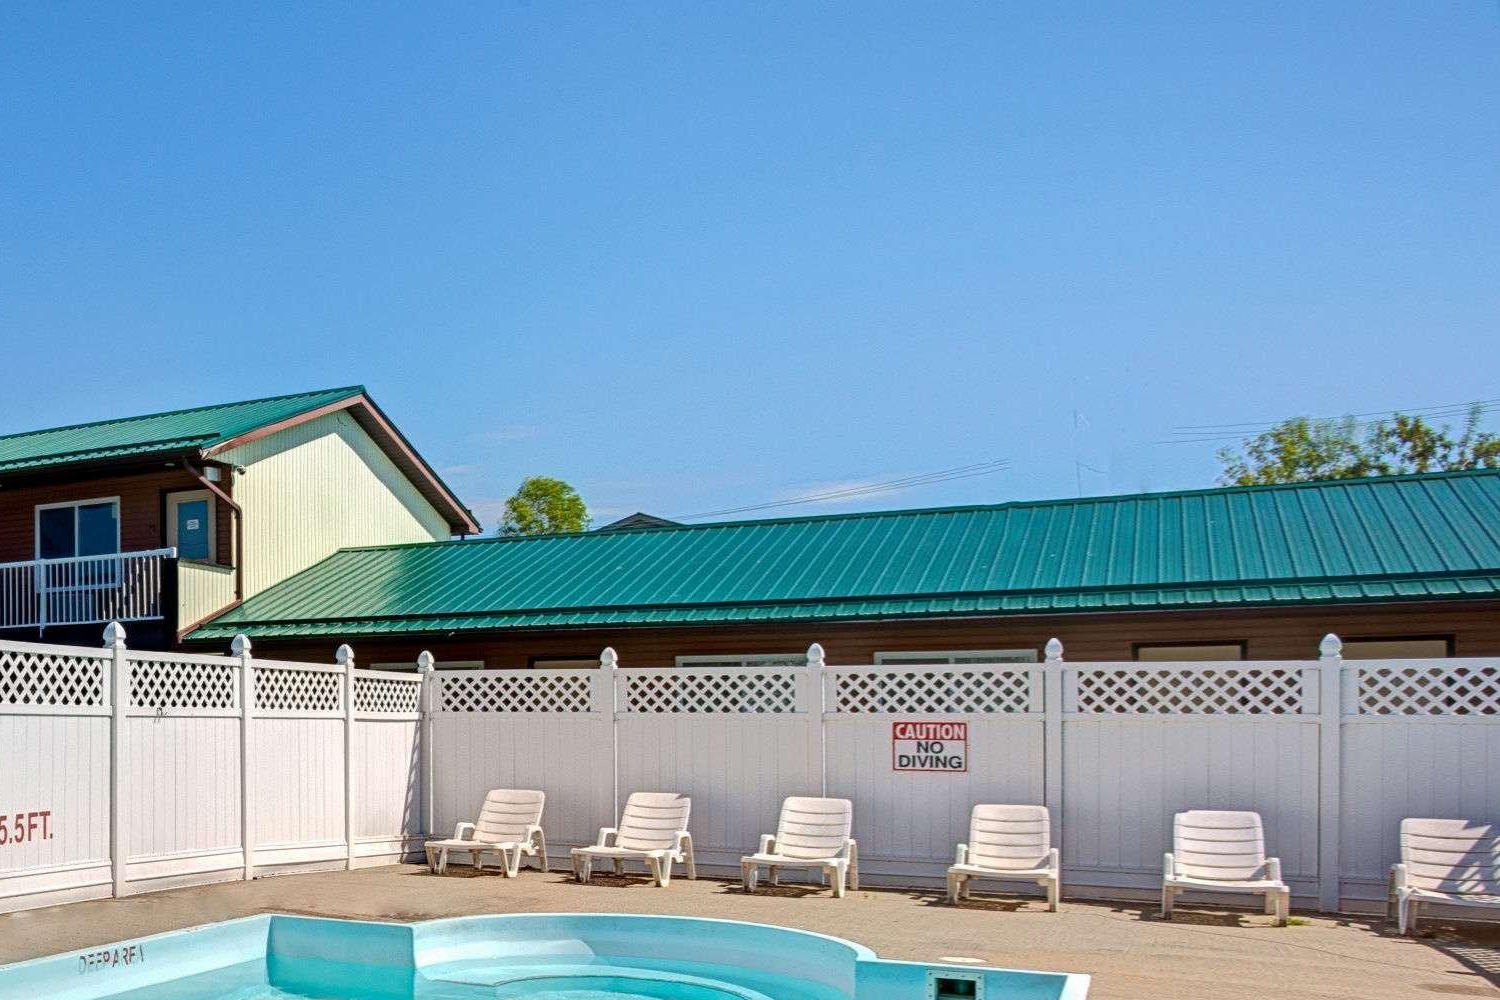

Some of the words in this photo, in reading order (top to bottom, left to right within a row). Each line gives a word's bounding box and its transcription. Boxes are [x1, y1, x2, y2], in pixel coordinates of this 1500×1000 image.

[895, 723, 965, 740] CAUTION
[916, 741, 944, 754] NO
[898, 755, 963, 769] DIVING
